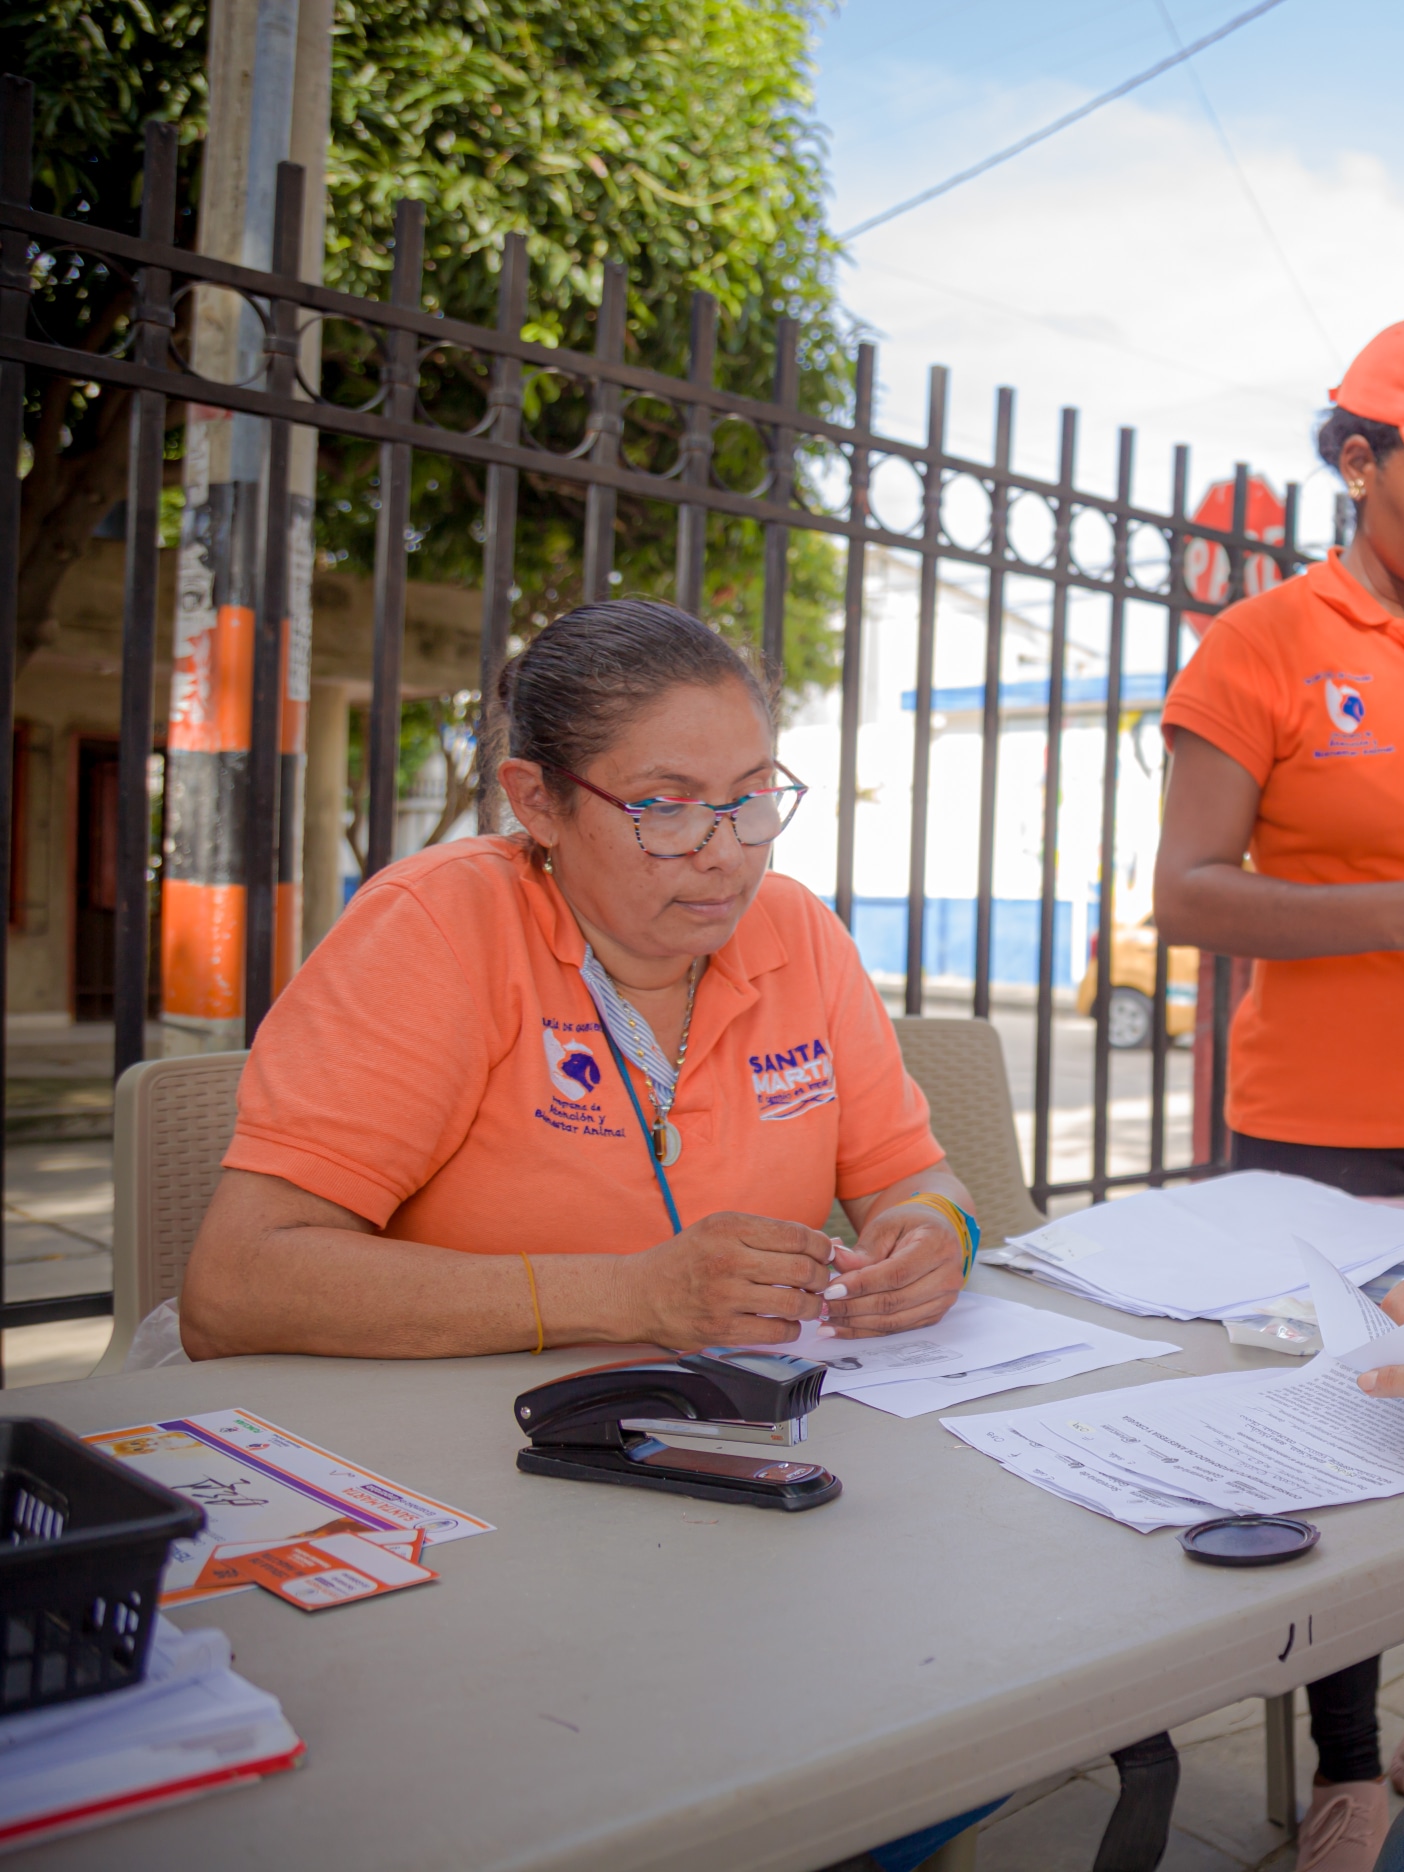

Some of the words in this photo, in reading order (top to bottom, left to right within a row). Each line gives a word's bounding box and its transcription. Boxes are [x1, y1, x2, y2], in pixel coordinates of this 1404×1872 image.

[748, 1039, 827, 1074] SANTA
[591, 1102, 602, 1112] de
[598, 1115, 607, 1125] y
[583, 1125, 627, 1138] Animal
[1150, 1431, 1188, 1450] ANESTESIA
[1192, 1453, 1239, 1472] INFORMADO
[1235, 1471, 1303, 1500] CONSENTIMIENTO
[340, 1486, 379, 1508] MARTA
[379, 1498, 420, 1523] SANTA
